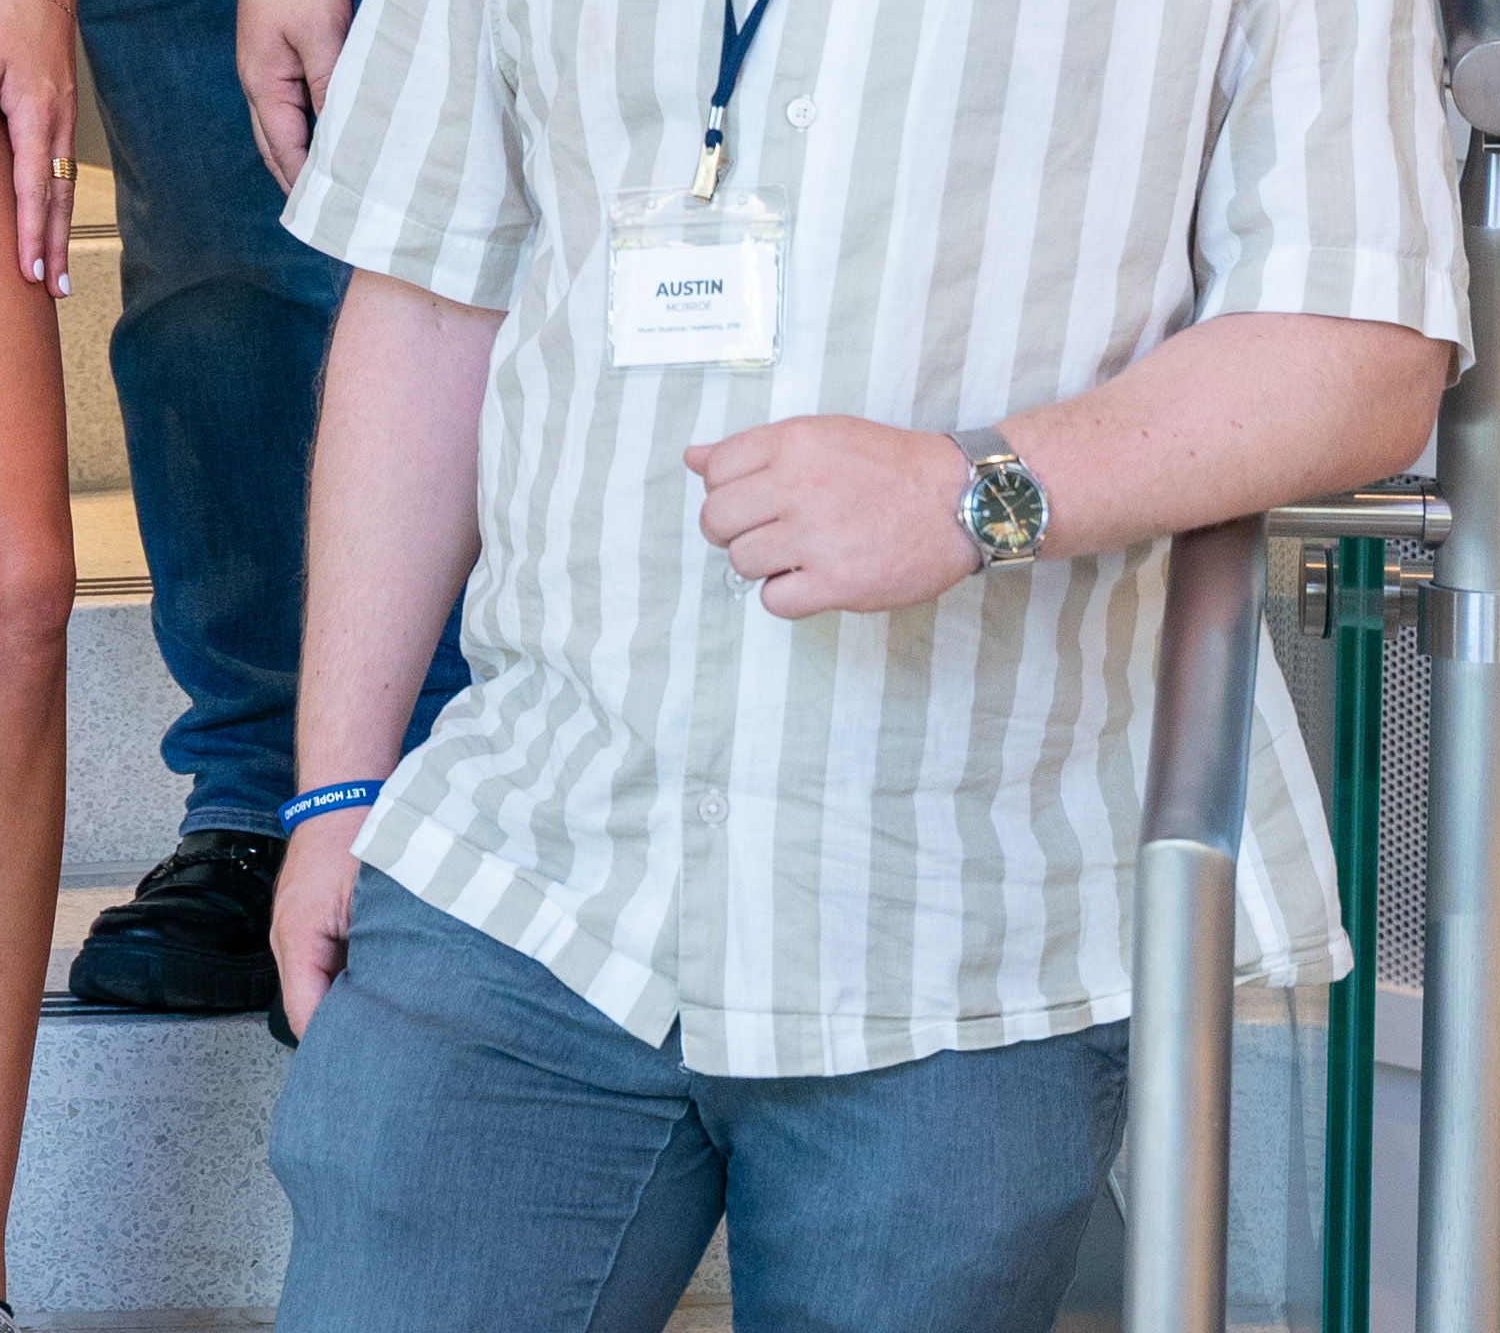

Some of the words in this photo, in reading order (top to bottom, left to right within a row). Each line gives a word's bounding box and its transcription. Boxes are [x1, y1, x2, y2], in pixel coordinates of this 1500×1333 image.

[656, 279, 724, 298] AUSTIN
[666, 301, 712, 313] MCBRIDE
[314, 791, 344, 806] HOPE
[346, 788, 366, 797] LET
[285, 798, 312, 820] ABOUND
